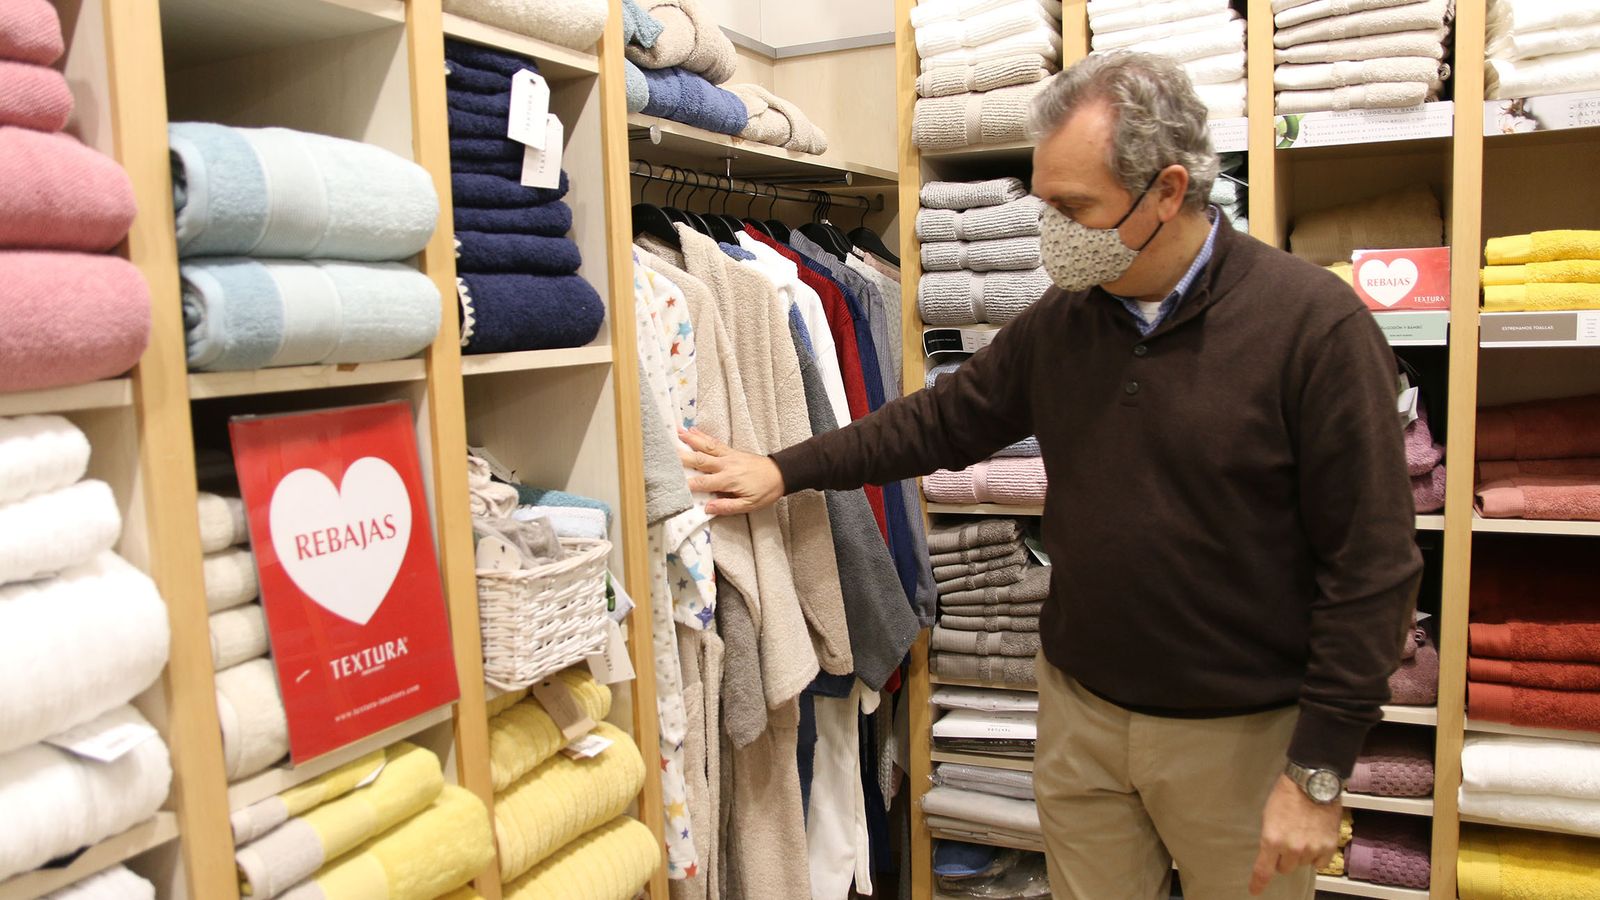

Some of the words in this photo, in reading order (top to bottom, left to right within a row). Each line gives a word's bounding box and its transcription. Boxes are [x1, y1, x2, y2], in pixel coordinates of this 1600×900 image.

[1366, 277, 1411, 287] REBAJAS
[1414, 295, 1446, 303] TEXTURA
[294, 513, 397, 561] REBAJAS
